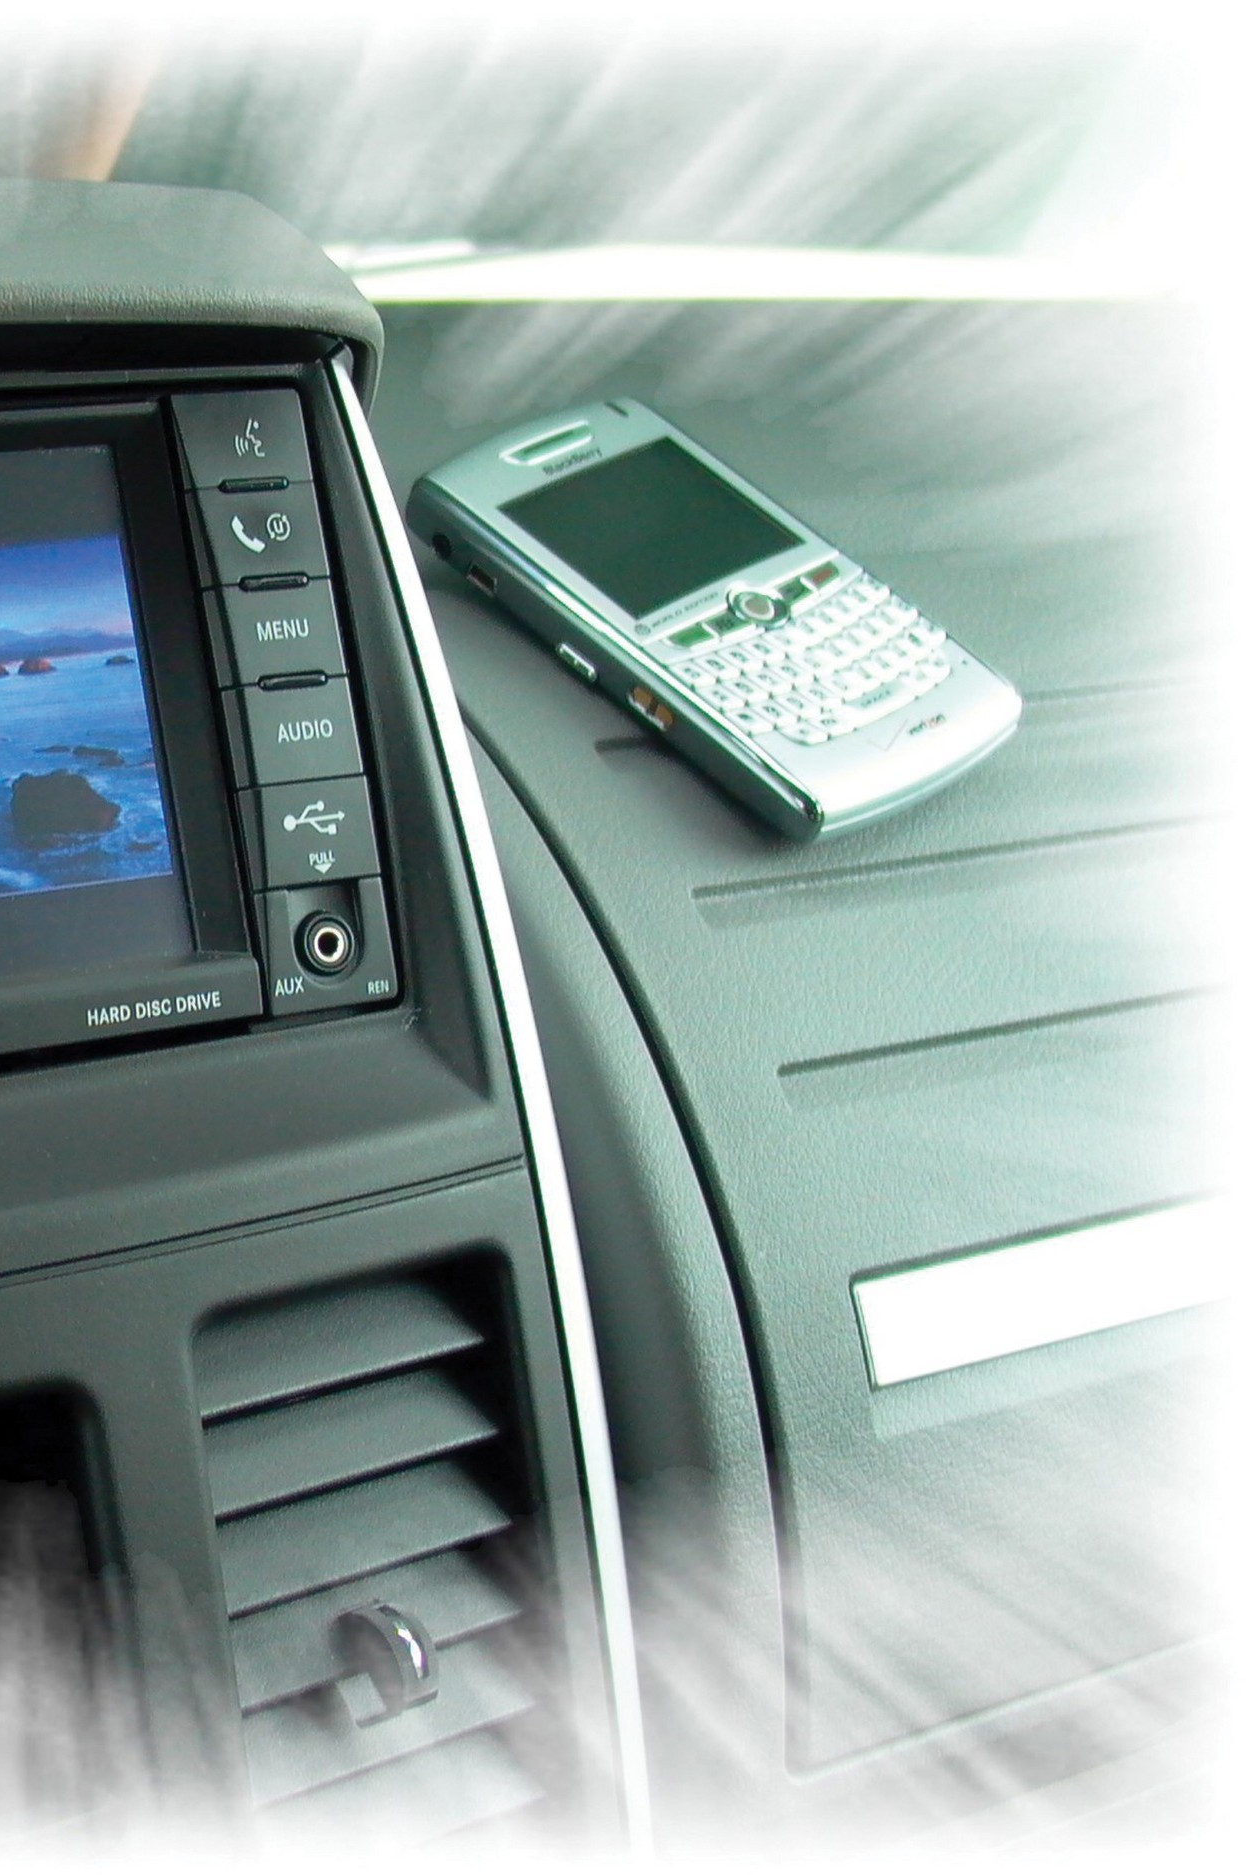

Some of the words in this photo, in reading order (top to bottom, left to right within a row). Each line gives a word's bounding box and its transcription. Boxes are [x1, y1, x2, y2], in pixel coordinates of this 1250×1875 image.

[256, 619, 309, 641] MENU
[277, 719, 334, 743] AUDIO
[308, 850, 336, 866] PULL
[274, 976, 305, 997] AUX
[367, 979, 390, 995] REN
[86, 1003, 132, 1027] HARD
[134, 997, 173, 1019] DISC
[176, 991, 222, 1014] DRIVE
